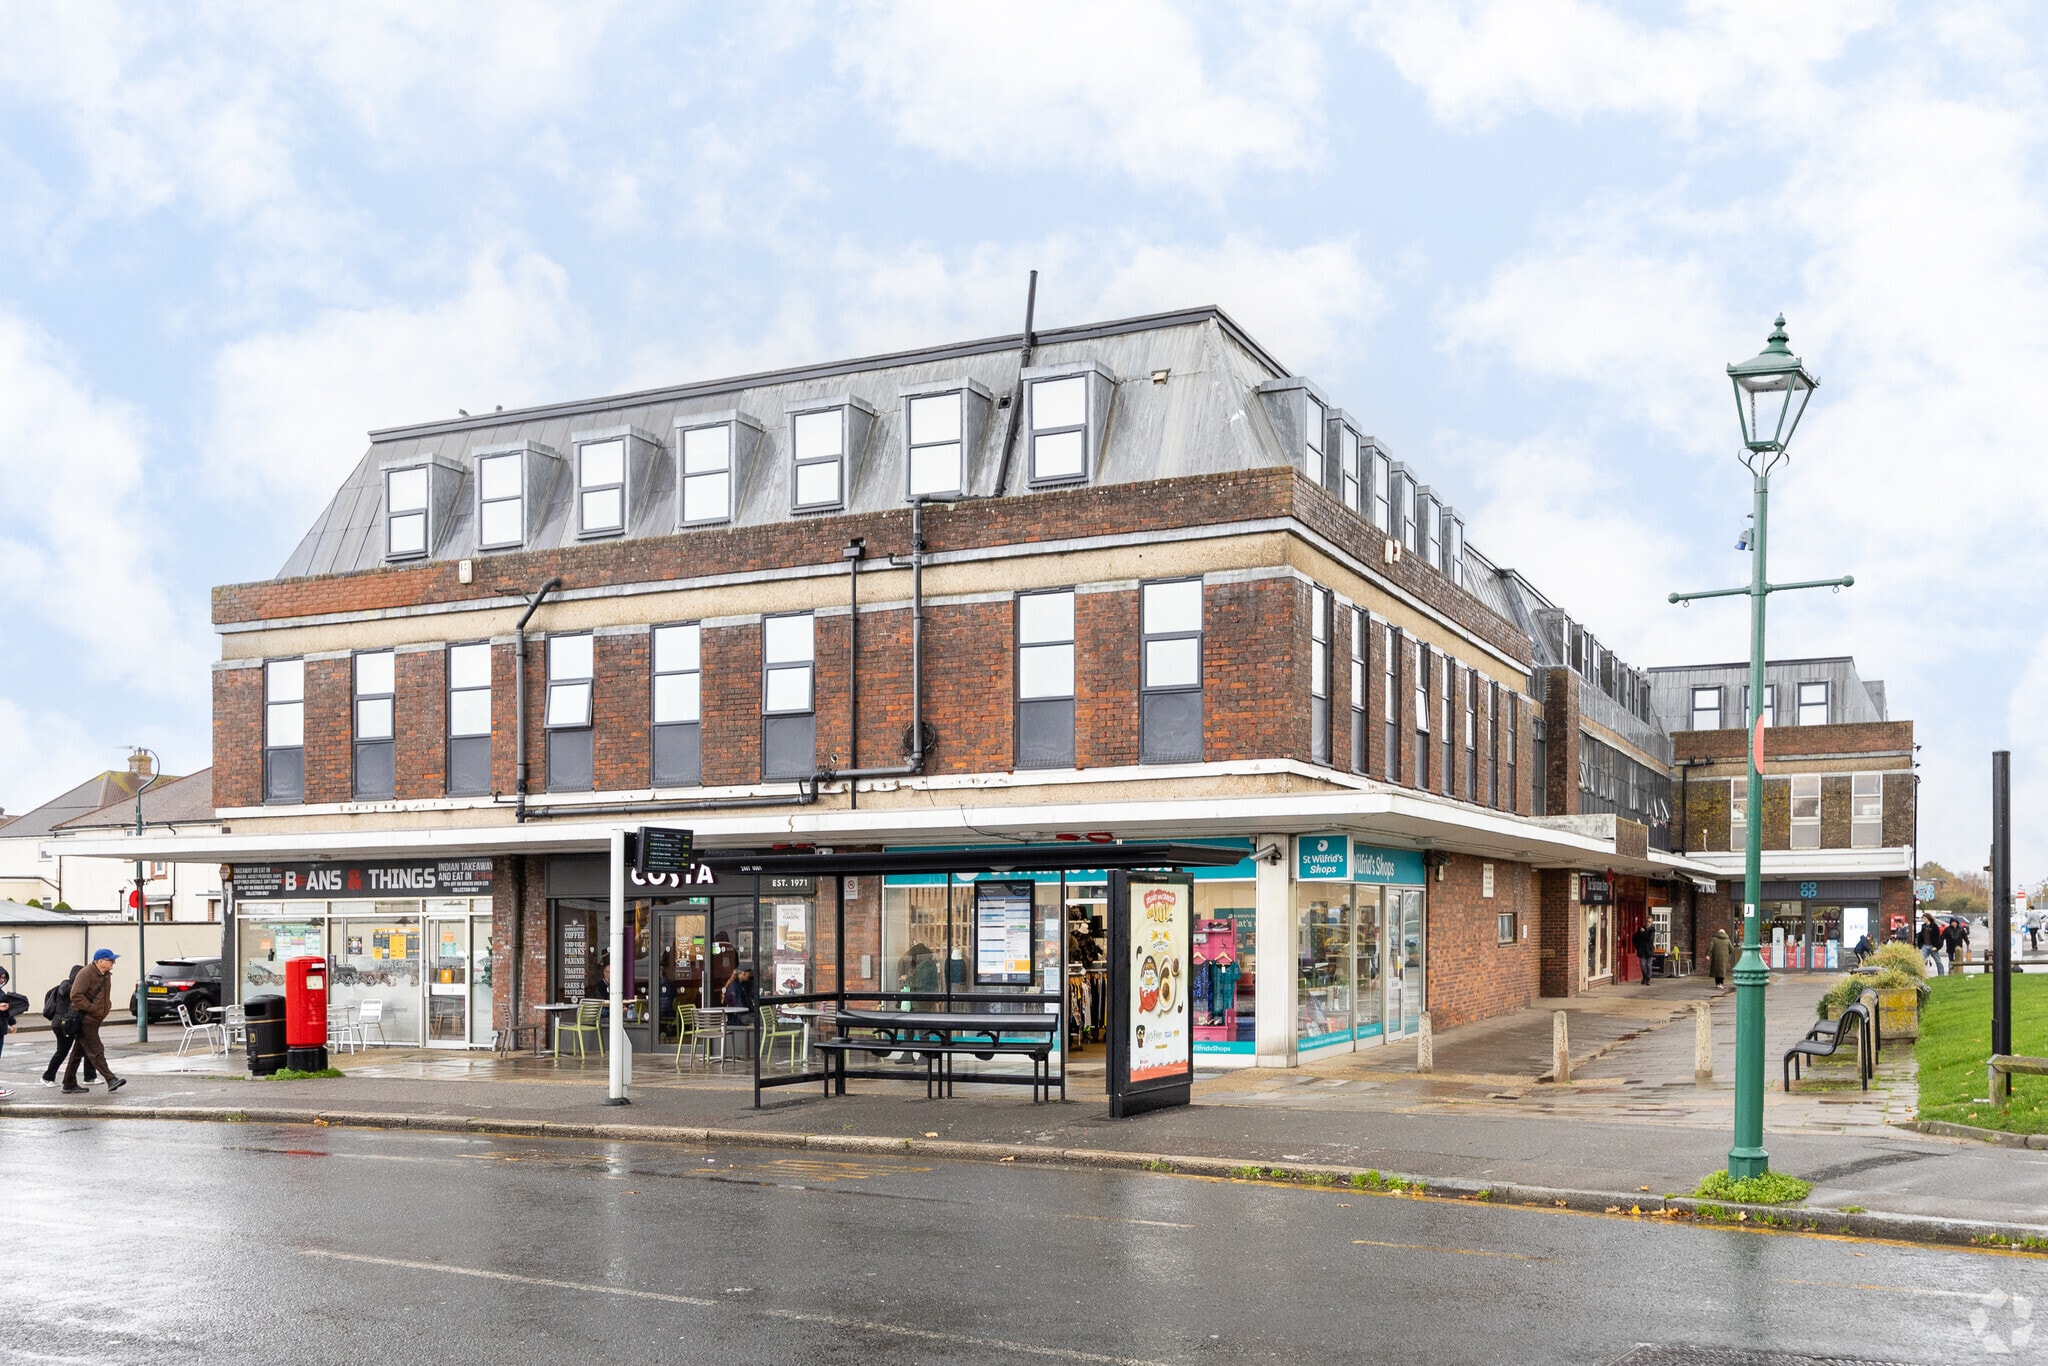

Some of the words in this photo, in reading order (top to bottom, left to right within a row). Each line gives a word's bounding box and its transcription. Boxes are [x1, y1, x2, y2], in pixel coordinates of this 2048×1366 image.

[1302, 855, 1312, 864] St
[1312, 854, 1343, 864] Wilfrid's
[438, 862, 460, 872] INDIAN
[461, 861, 493, 872] TAKEAWAY
[1310, 864, 1337, 875] Shops
[1375, 854, 1395, 881] Shops
[368, 868, 436, 890] THINGS
[438, 872, 452, 881] AND
[452, 872, 464, 881] EAT
[465, 872, 472, 881] IN
[772, 879, 789, 888] EST.
[790, 878, 808, 888] 1971
[1745, 905, 1751, 915] J
[564, 947, 586, 955] DRINKS
[564, 957, 586, 965] PANINIS
